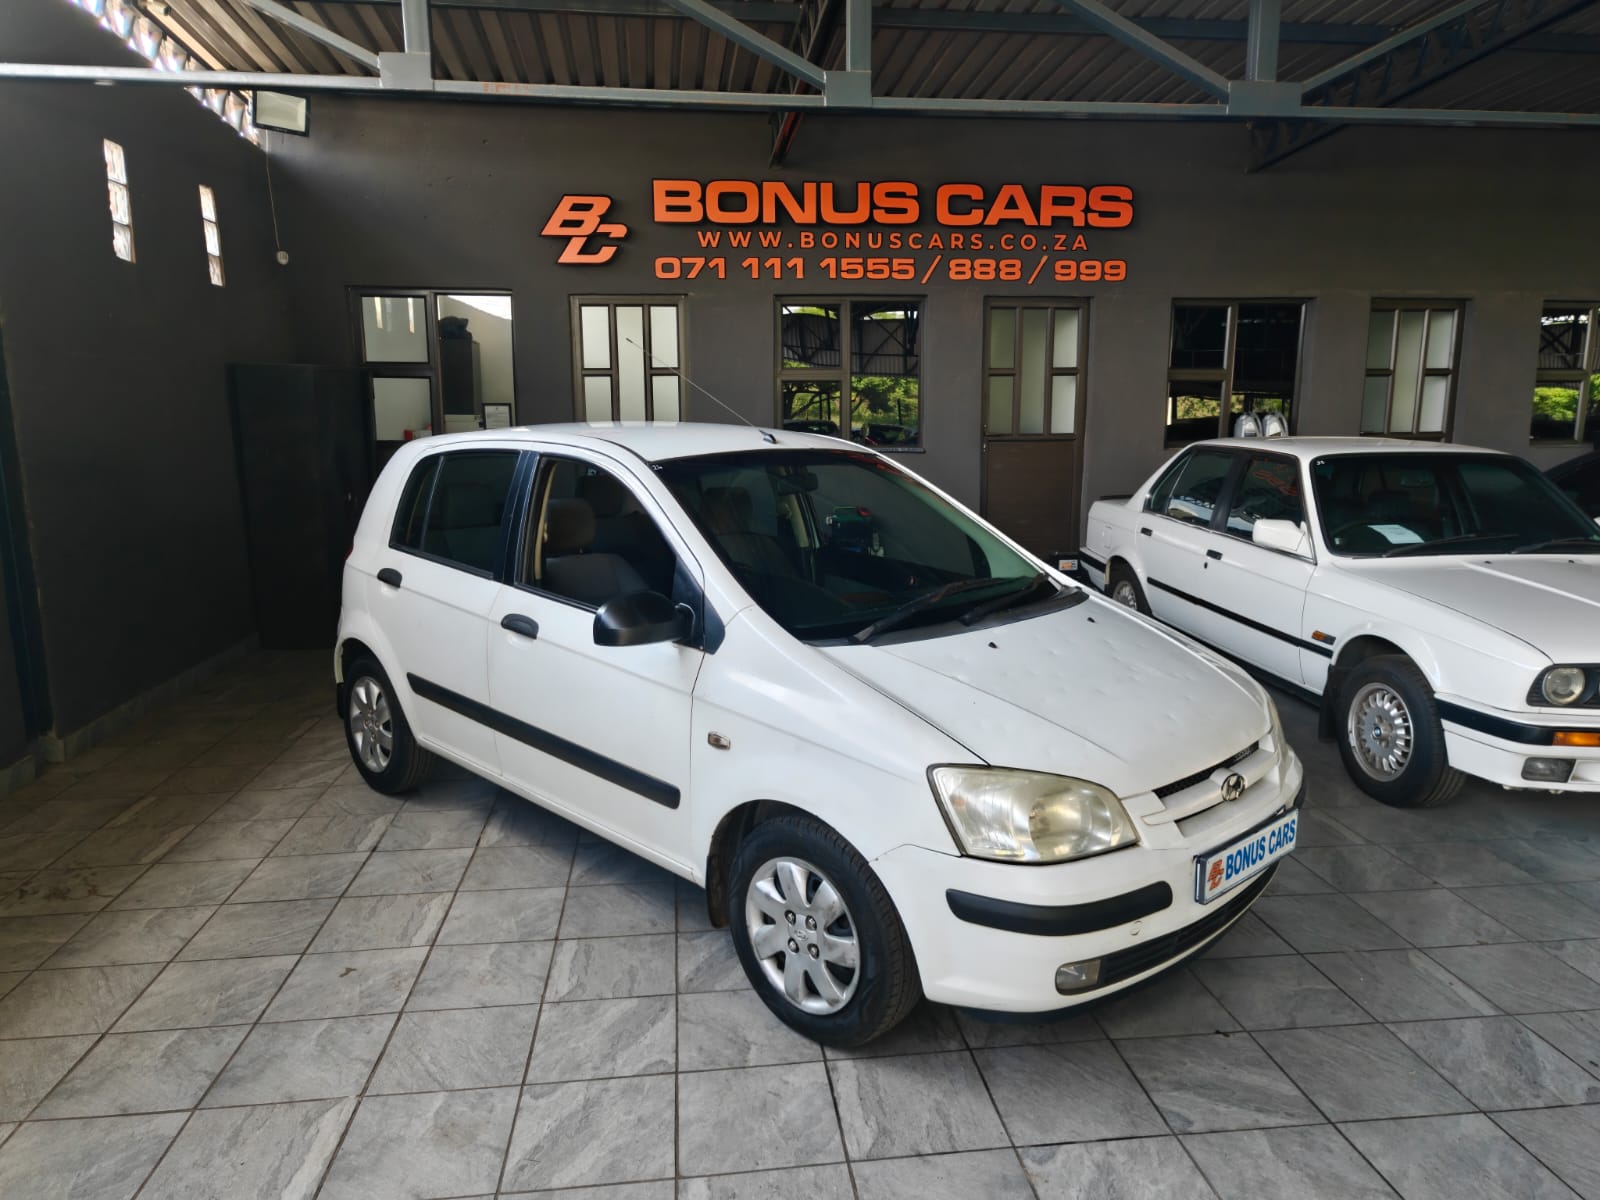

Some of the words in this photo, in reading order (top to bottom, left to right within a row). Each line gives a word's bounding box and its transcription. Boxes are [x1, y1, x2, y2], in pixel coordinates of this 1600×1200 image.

[653, 180, 920, 225] BONUS
[935, 183, 1134, 228] CARS
[697, 231, 1089, 251] WWW.BONUSCARS.CO.ZA
[654, 257, 726, 279] 071
[741, 257, 805, 279] 111
[1225, 836, 1266, 881] BONUS
[1268, 819, 1296, 855] CARS
